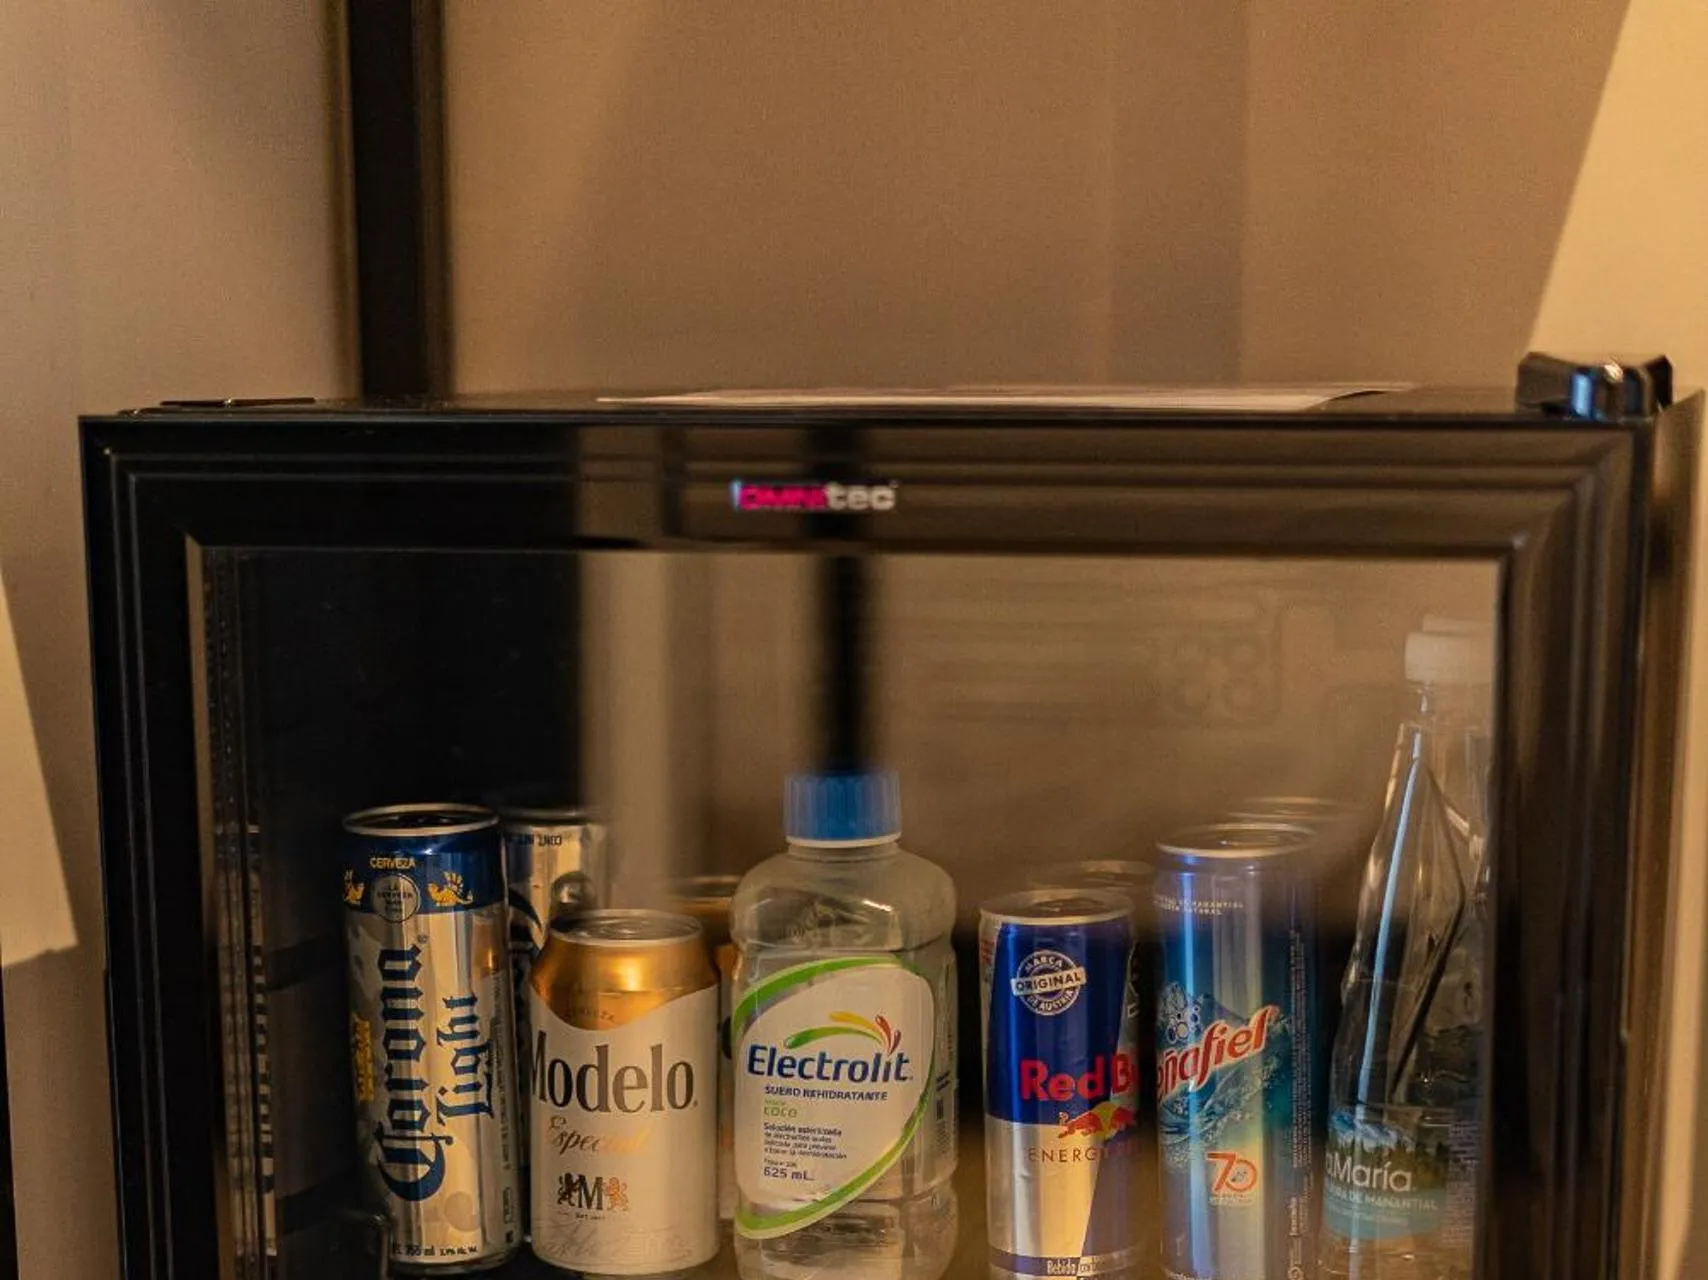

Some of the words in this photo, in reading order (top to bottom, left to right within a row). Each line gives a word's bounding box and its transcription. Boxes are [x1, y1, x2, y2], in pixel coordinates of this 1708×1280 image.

[1015, 971, 1081, 993] ORIGINAL
[375, 943, 453, 1202] Corona
[436, 993, 494, 1127] Light
[532, 1029, 698, 1113] Modelo
[747, 1044, 911, 1084] Electrolit
[1157, 1004, 1277, 1099] ñafiel
[765, 1085, 801, 1097] SUERO
[802, 1088, 889, 1101] REHIDRATANTE
[1020, 1054, 1104, 1101] Red
[763, 1167, 788, 1179] 625
[1028, 1146, 1106, 1163] ENERG
[1206, 1151, 1258, 1193] 70
